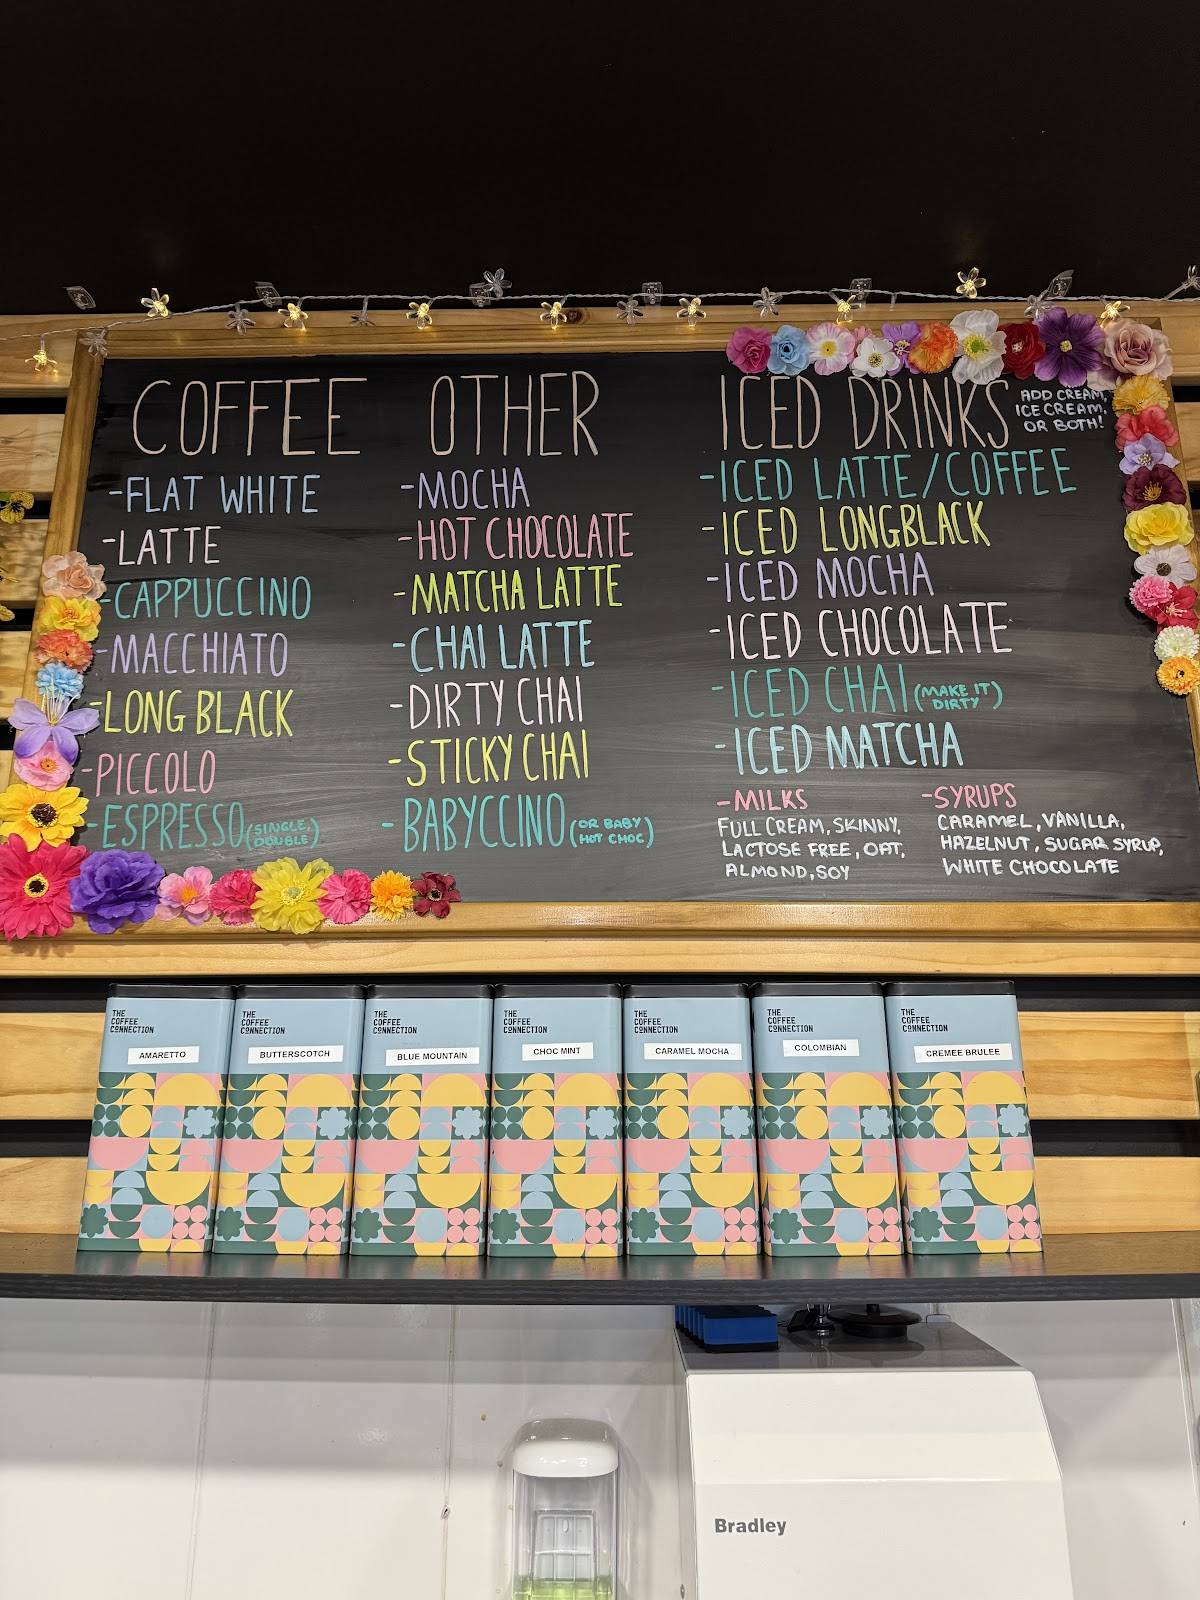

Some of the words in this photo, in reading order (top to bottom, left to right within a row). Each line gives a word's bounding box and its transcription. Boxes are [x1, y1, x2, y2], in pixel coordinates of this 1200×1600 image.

[1021, 389, 1053, 402] ADD
[430, 371, 600, 457] OTHER
[721, 375, 821, 451] ICED
[847, 376, 1009, 450] DRINKS
[1015, 404, 1041, 417] ICE
[132, 377, 368, 456] COFFEE
[1023, 420, 1049, 433] OR
[1053, 415, 1104, 432] BOTH!
[813, 447, 1077, 501] LATTE/COFFEE
[221, 474, 320, 514] WHITE
[485, 512, 634, 560] CHOCOLATE
[816, 551, 935, 599] MOCHA
[536, 564, 623, 610] LATTE
[817, 602, 1013, 658] CHOCOLATE
[500, 619, 595, 670] LATTE
[825, 663, 910, 714] CHAI
[518, 675, 583, 725] CHAI
[196, 689, 293, 738] BLACK
[826, 721, 964, 770] MATCHA
[522, 729, 589, 782] CHAI
[603, 817, 641, 829] BABY
[1042, 811, 1126, 831] VANILLA,
[717, 817, 762, 839] FULL
[765, 816, 831, 836] CREAM,
[833, 816, 901, 835] SKINNY,
[579, 833, 603, 844] HOT
[722, 840, 801, 858] LACTOSE
[863, 841, 905, 859] OAT,
[1044, 836, 1109, 852] SUGAR
[1113, 836, 1164, 856] SYRUP,
[942, 857, 1003, 876] WHITE
[1009, 858, 1120, 876] CHOCOLATE
[112, 1009, 126, 1017] THE
[242, 1010, 256, 1018] THE
[374, 1010, 388, 1018] THE
[503, 1010, 518, 1018] THE
[634, 1010, 648, 1018] THE
[767, 1008, 781, 1016] THE
[900, 1008, 915, 1016] THE
[241, 1018, 270, 1026] COFFEE
[373, 1018, 401, 1026] COFFEE
[503, 1018, 531, 1026] COFFEE
[634, 1018, 662, 1026] COFFEE
[767, 1017, 796, 1025] COFFEE
[901, 1016, 930, 1024] COFFEE
[109, 1026, 155, 1034] CONNECTION
[240, 1026, 286, 1035] CONNECTION
[372, 1026, 418, 1034] CONNECTION
[503, 1025, 548, 1034] CONNECTION
[634, 1026, 679, 1034] CONNECTION
[768, 1025, 814, 1033] CONNECTION
[902, 1024, 949, 1032] CONNECTION
[533, 1047, 559, 1055] CHOC
[560, 1047, 581, 1055] MINT
[655, 1047, 696, 1055] CARAMEL
[698, 1047, 730, 1055] MOCHA
[794, 1044, 847, 1052] COLOMBIAN
[926, 1049, 963, 1057] CREMEE
[965, 1048, 1000, 1056] BRULEE
[139, 1051, 187, 1059] AMARETTO
[259, 1050, 330, 1059] BUTTERSCOTCH
[397, 1053, 420, 1061] BLUE
[422, 1052, 468, 1060] MOUNTAIN
[714, 1518, 787, 1536] Bradley
